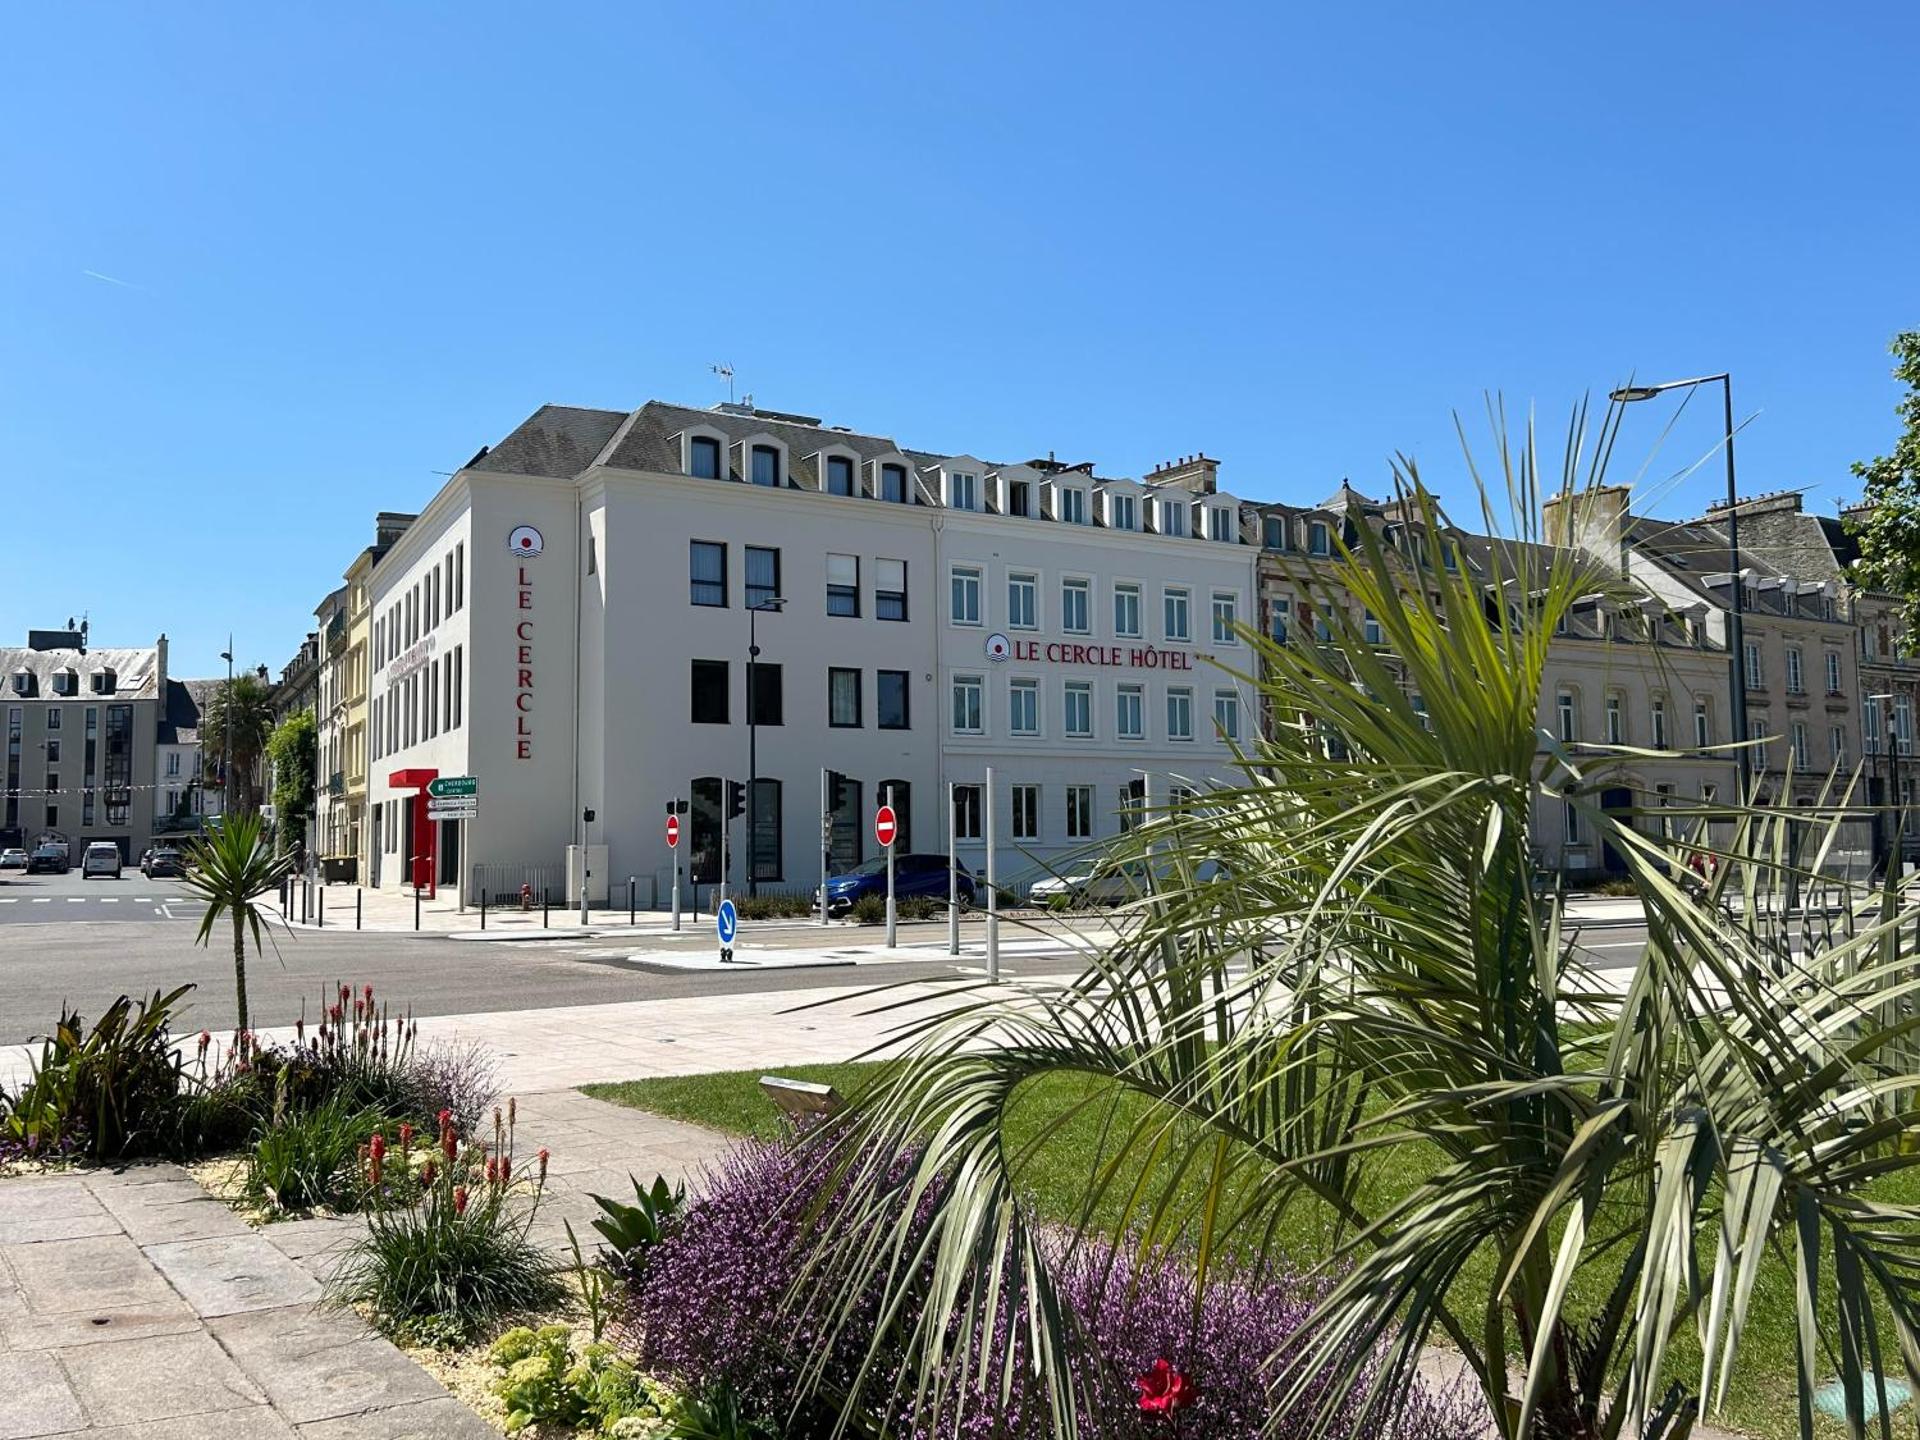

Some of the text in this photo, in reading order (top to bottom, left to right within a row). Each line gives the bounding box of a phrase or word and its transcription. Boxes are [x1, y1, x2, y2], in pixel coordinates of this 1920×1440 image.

[516, 567, 533, 760] LE CERCLE
[1015, 639, 1192, 670] LE CERCLE HÔTEL
